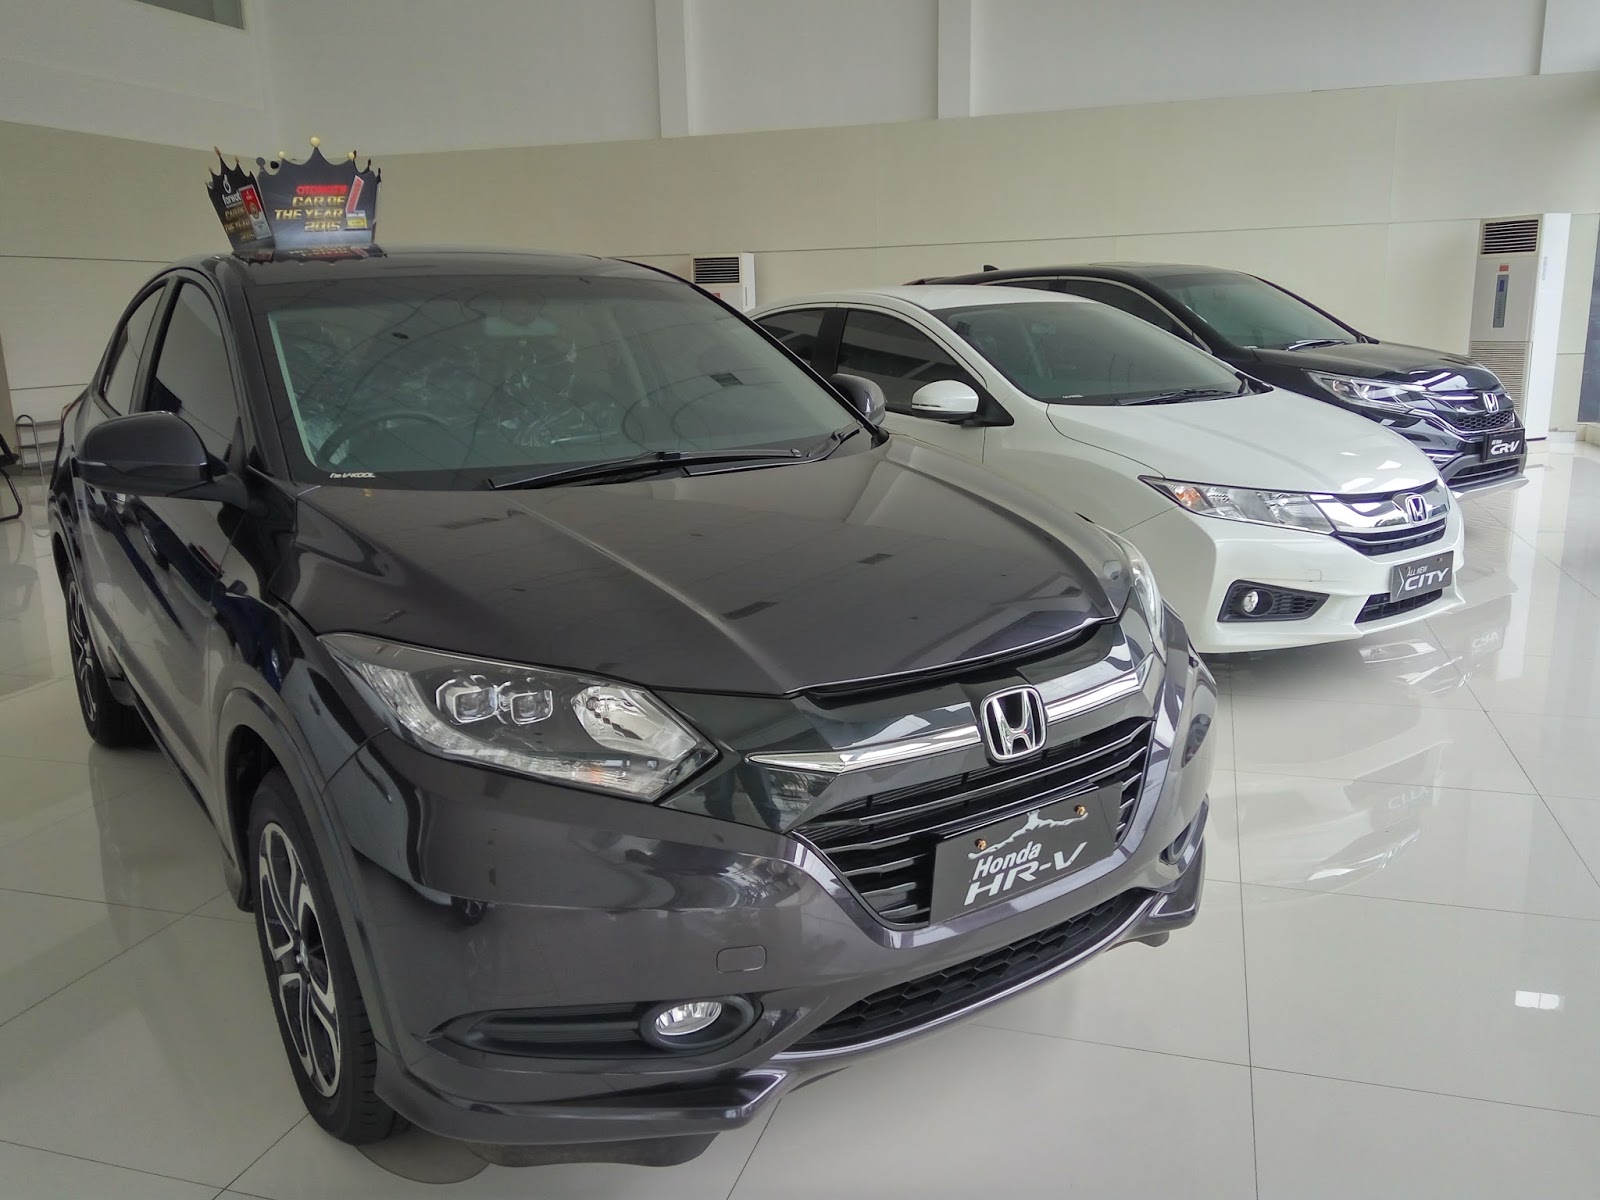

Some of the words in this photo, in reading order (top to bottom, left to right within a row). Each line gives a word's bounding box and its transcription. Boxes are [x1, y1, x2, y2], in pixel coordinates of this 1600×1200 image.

[292, 196, 325, 207] CAR
[326, 195, 346, 207] OF
[274, 209, 302, 220] THE
[304, 208, 344, 220] YEAR
[304, 221, 341, 233] 2015
[1406, 568, 1416, 577] ALL
[1416, 565, 1429, 574] NEW
[1404, 567, 1449, 591] CITY
[972, 841, 1042, 881] Honda
[963, 841, 1088, 906] HR-V
